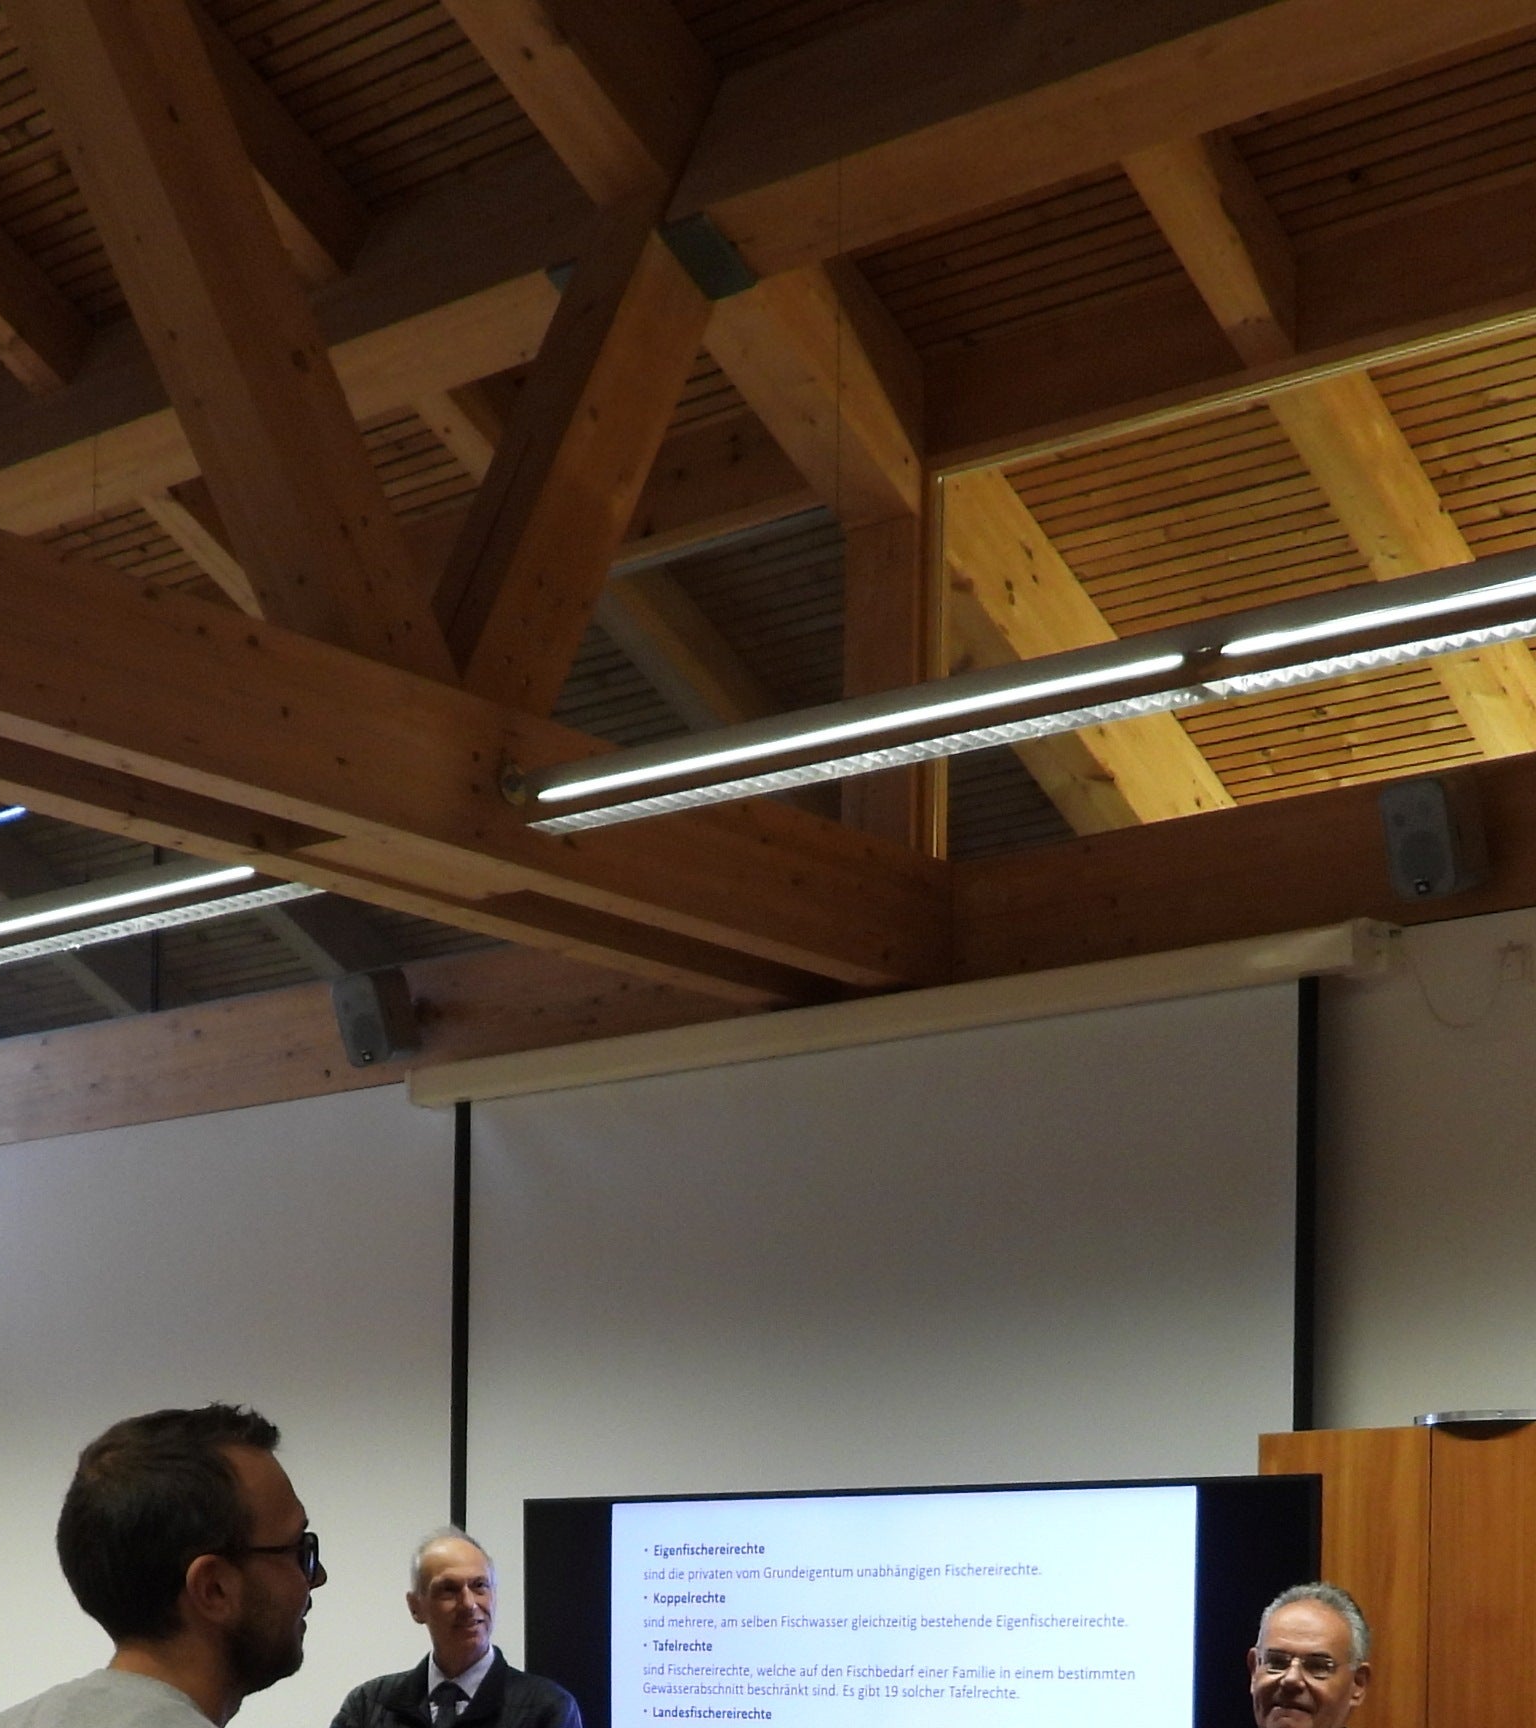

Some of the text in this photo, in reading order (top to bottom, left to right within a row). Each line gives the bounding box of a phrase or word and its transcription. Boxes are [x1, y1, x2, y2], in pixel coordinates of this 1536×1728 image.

[653, 1541, 765, 1559] Eigenfischereirechte
[643, 1562, 1042, 1582] sind die privaten vom Grundeigentum unabhängigen Fischereirechte.
[653, 1590, 726, 1607] Koppelrechte
[643, 1614, 1128, 1630] sind mehrere, am selben Fischwasser gleichzeitig bestehende Eigenfischereirechte.
[652, 1638, 713, 1652] Tafelrechte
[643, 1663, 1136, 1680] sind Fischereirechte, welche auf den Fischbedarf einer Familie in einem bestimmten
[642, 1681, 1020, 1700] Gewässerabschnitt beschränkt sind. Es gibt 19 solcher Tafelrechte.
[652, 1705, 772, 1720] Landesfischereirechte
